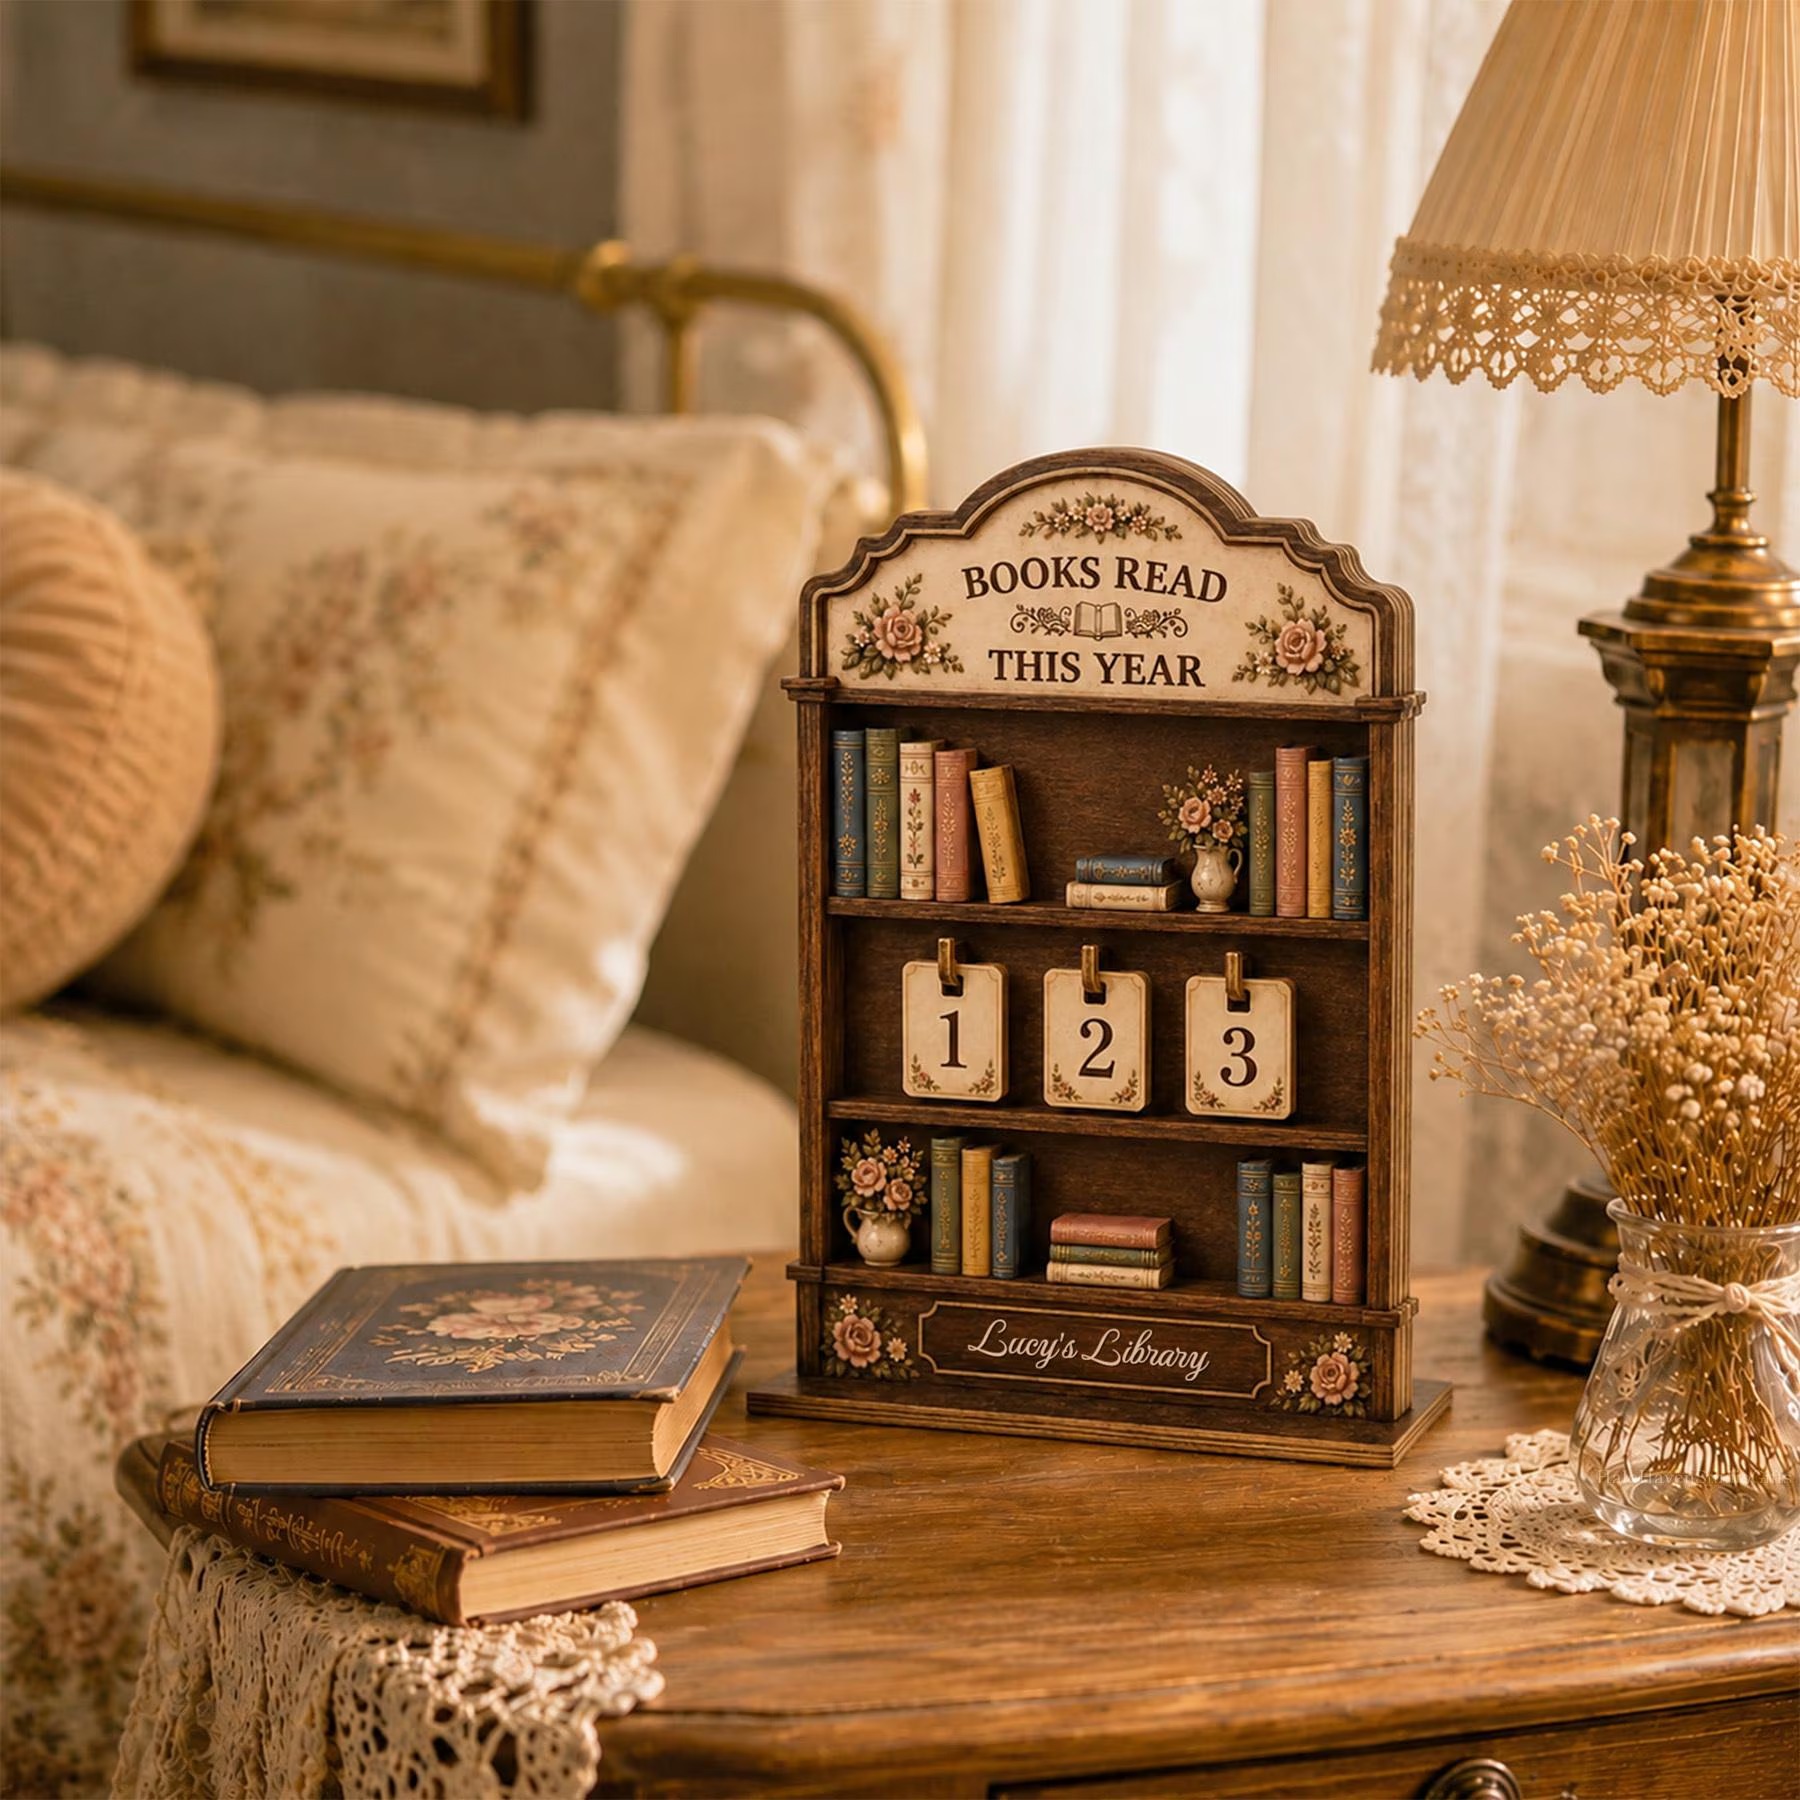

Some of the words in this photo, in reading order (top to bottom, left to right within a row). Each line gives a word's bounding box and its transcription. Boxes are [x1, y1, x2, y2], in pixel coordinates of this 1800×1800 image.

[961, 555, 1101, 599] BOOKS
[1114, 556, 1228, 603] READ
[988, 649, 1081, 683] THIS
[1093, 652, 1206, 687] YEAR
[939, 1010, 967, 1069] 1
[1078, 1018, 1115, 1079] 2
[1220, 1027, 1258, 1087] 3
[967, 1319, 1078, 1369] Lucy's
[1081, 1328, 1210, 1382] Library
